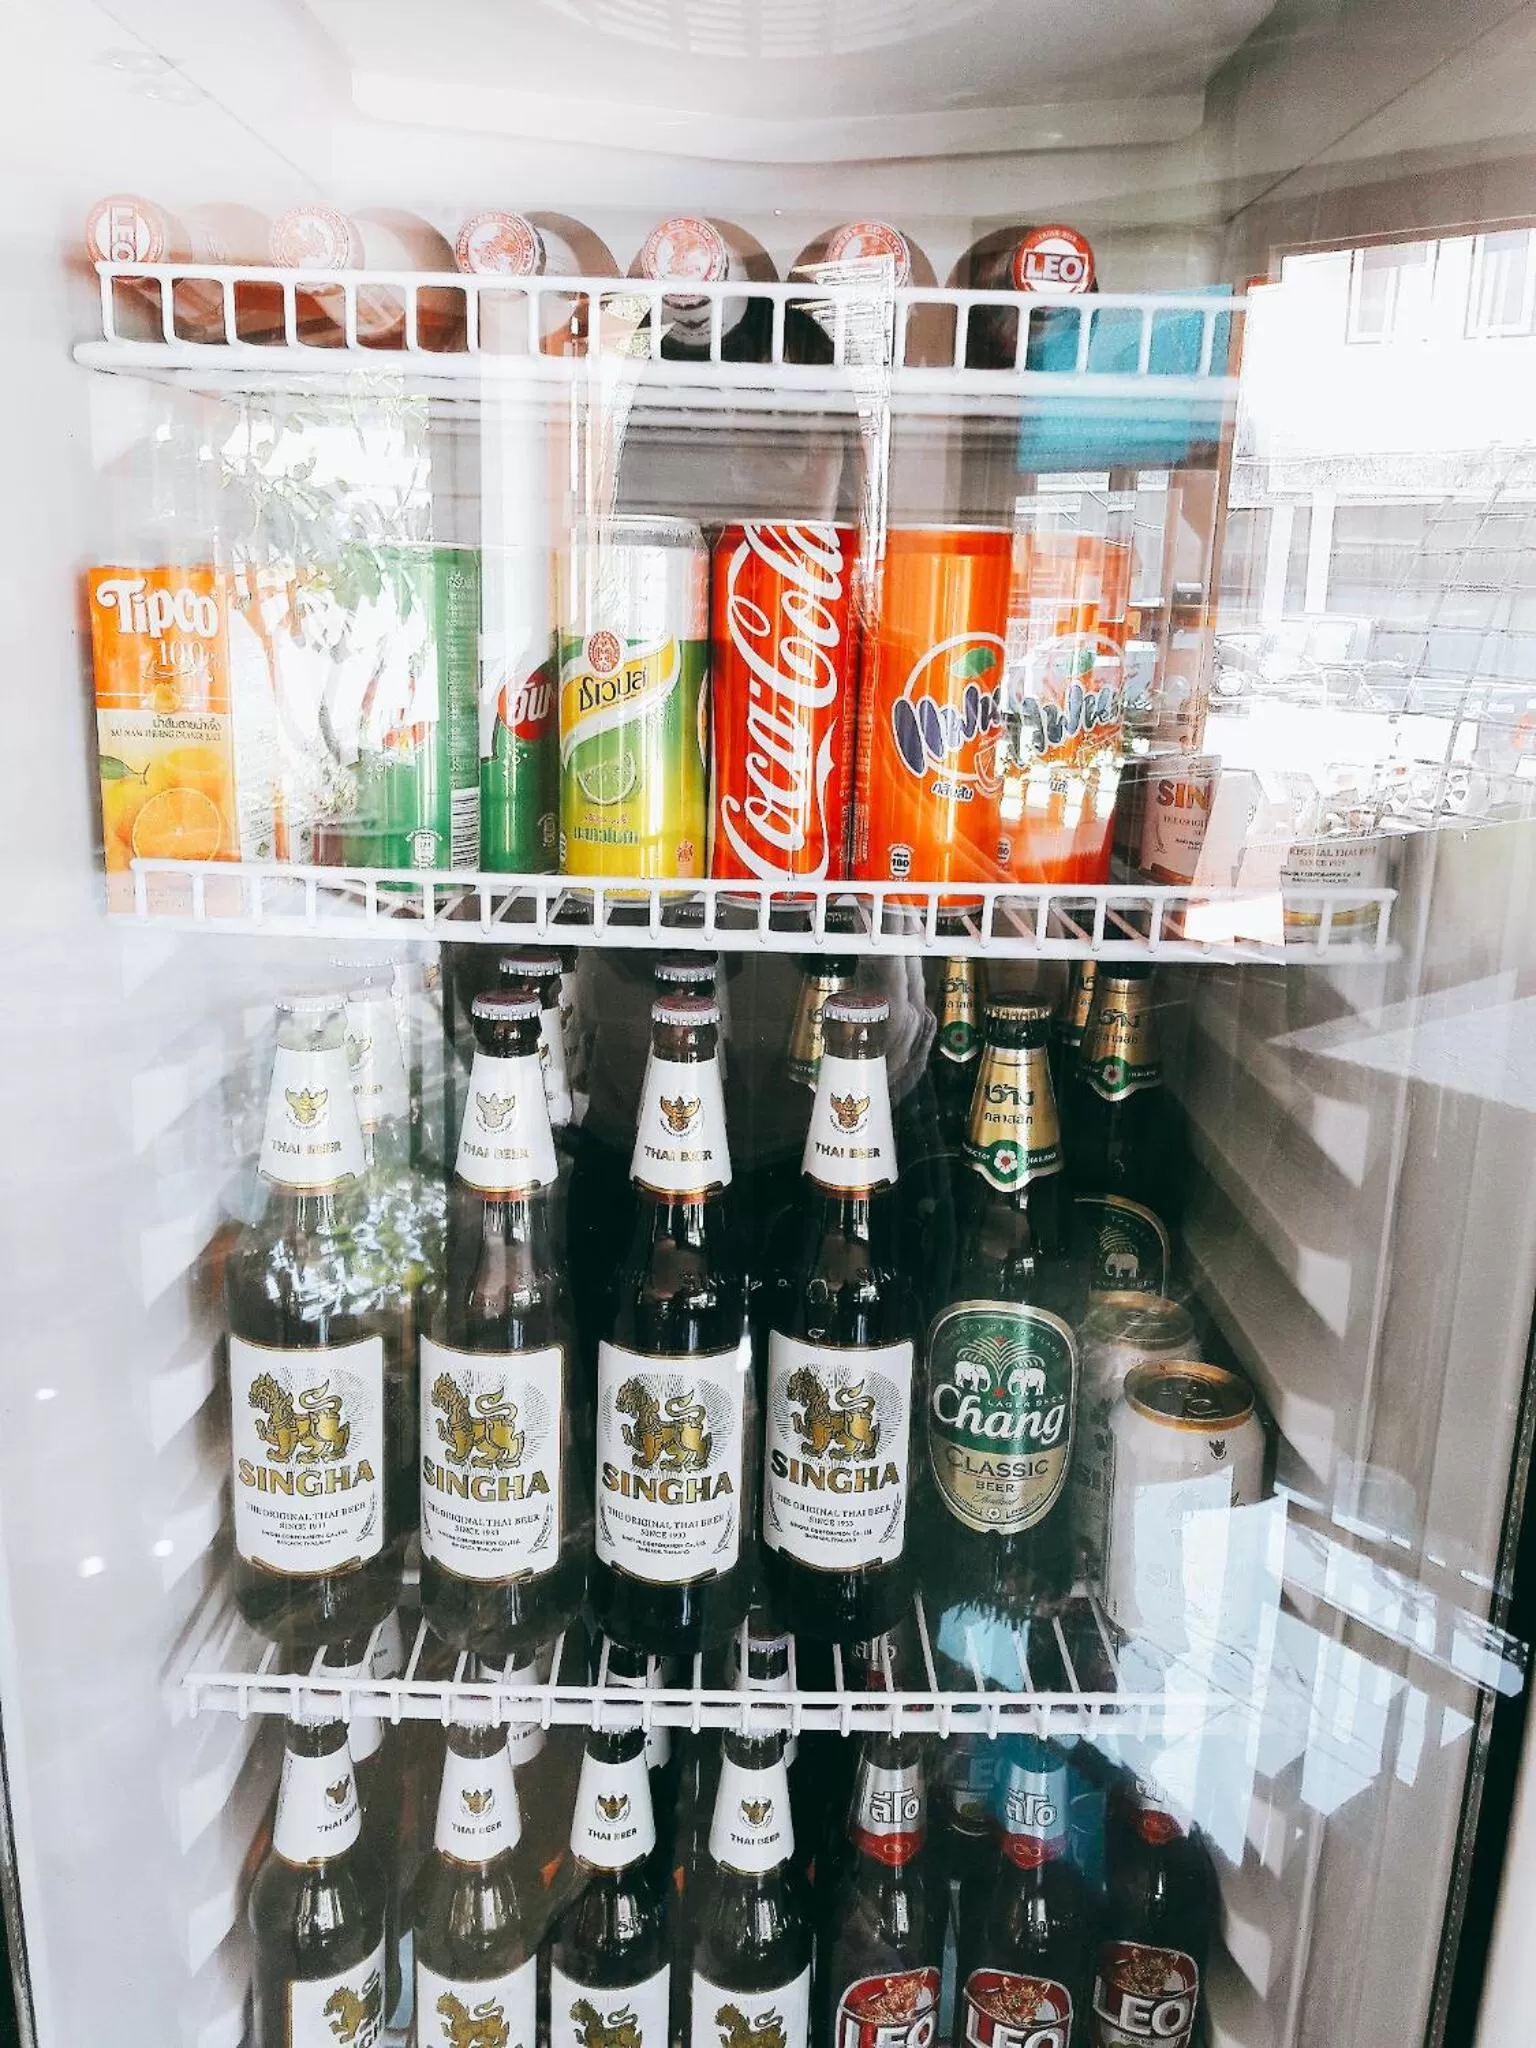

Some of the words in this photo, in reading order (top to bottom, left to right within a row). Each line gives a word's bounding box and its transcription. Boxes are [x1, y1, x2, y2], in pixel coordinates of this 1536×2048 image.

[1025, 252, 1085, 284] LEO
[96, 578, 219, 640] Tipco
[643, 1144, 676, 1161] THAI
[813, 1140, 844, 1158] THAI
[849, 1146, 881, 1159] BEER
[932, 1382, 1066, 1446] Chang
[238, 1457, 375, 1497] SINGHA
[770, 1448, 900, 1494] SINGHA
[946, 1444, 1049, 1478] CLASSIC
[421, 1454, 551, 1503] SINGHA
[601, 1460, 734, 1506] SINGHA
[976, 1479, 1015, 1494] BEER
[451, 1821, 476, 1835] THAI
[587, 1827, 611, 1841] THAI
[730, 1832, 755, 1846] THAI
[1093, 1974, 1192, 2036] LEO
